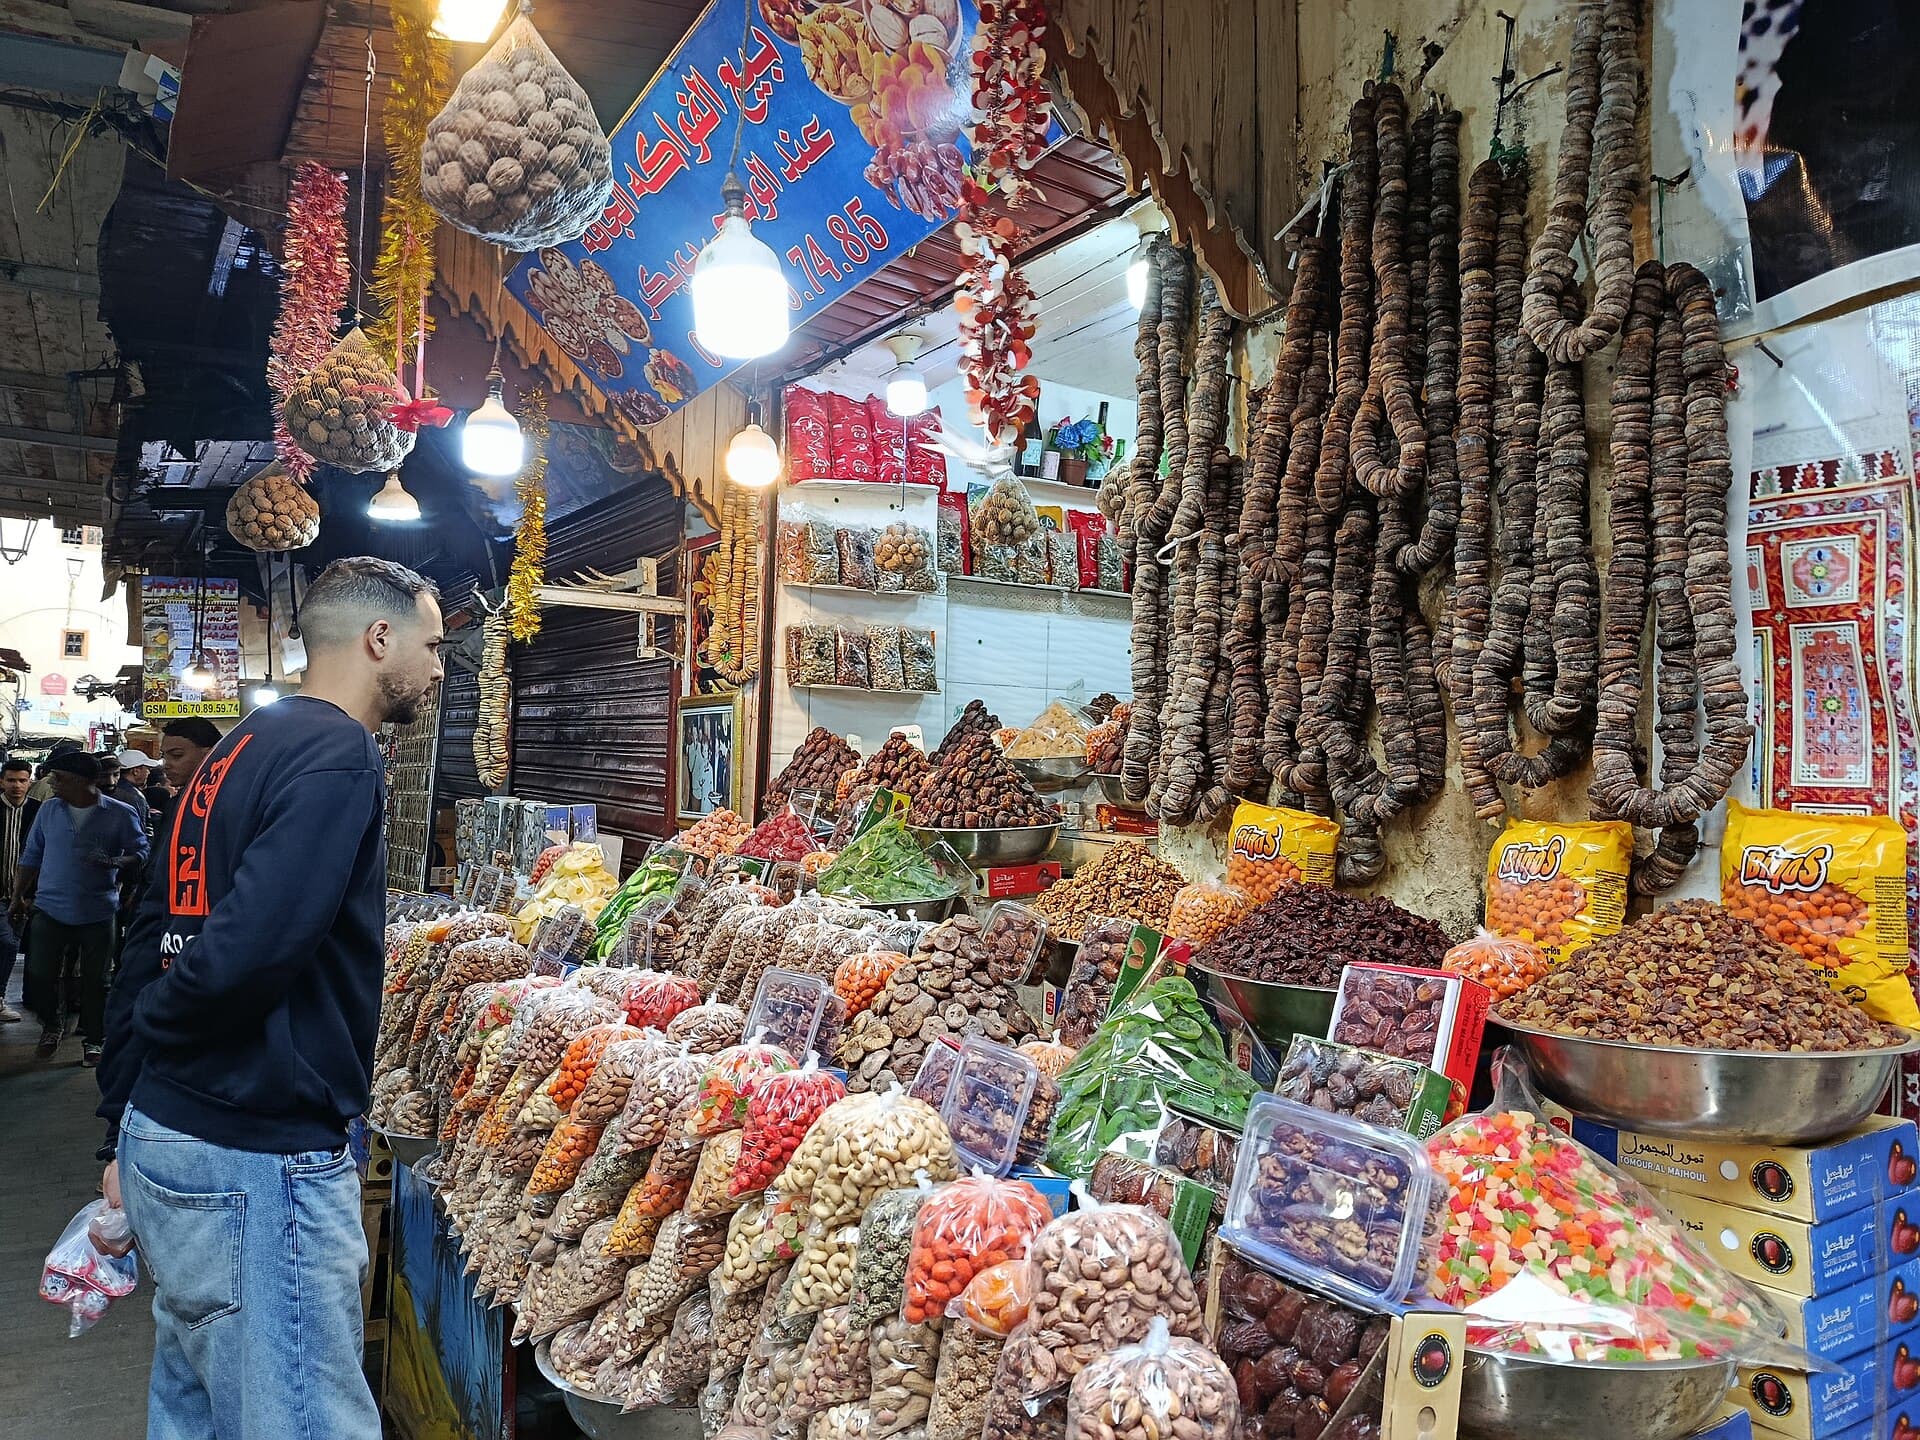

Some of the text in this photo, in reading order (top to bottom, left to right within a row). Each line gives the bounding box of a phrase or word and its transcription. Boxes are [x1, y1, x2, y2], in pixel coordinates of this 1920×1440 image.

[145, 704, 167, 714] GSM
[1619, 1154, 1654, 1171] TOMOUR
[1653, 1162, 1666, 1173] AL
